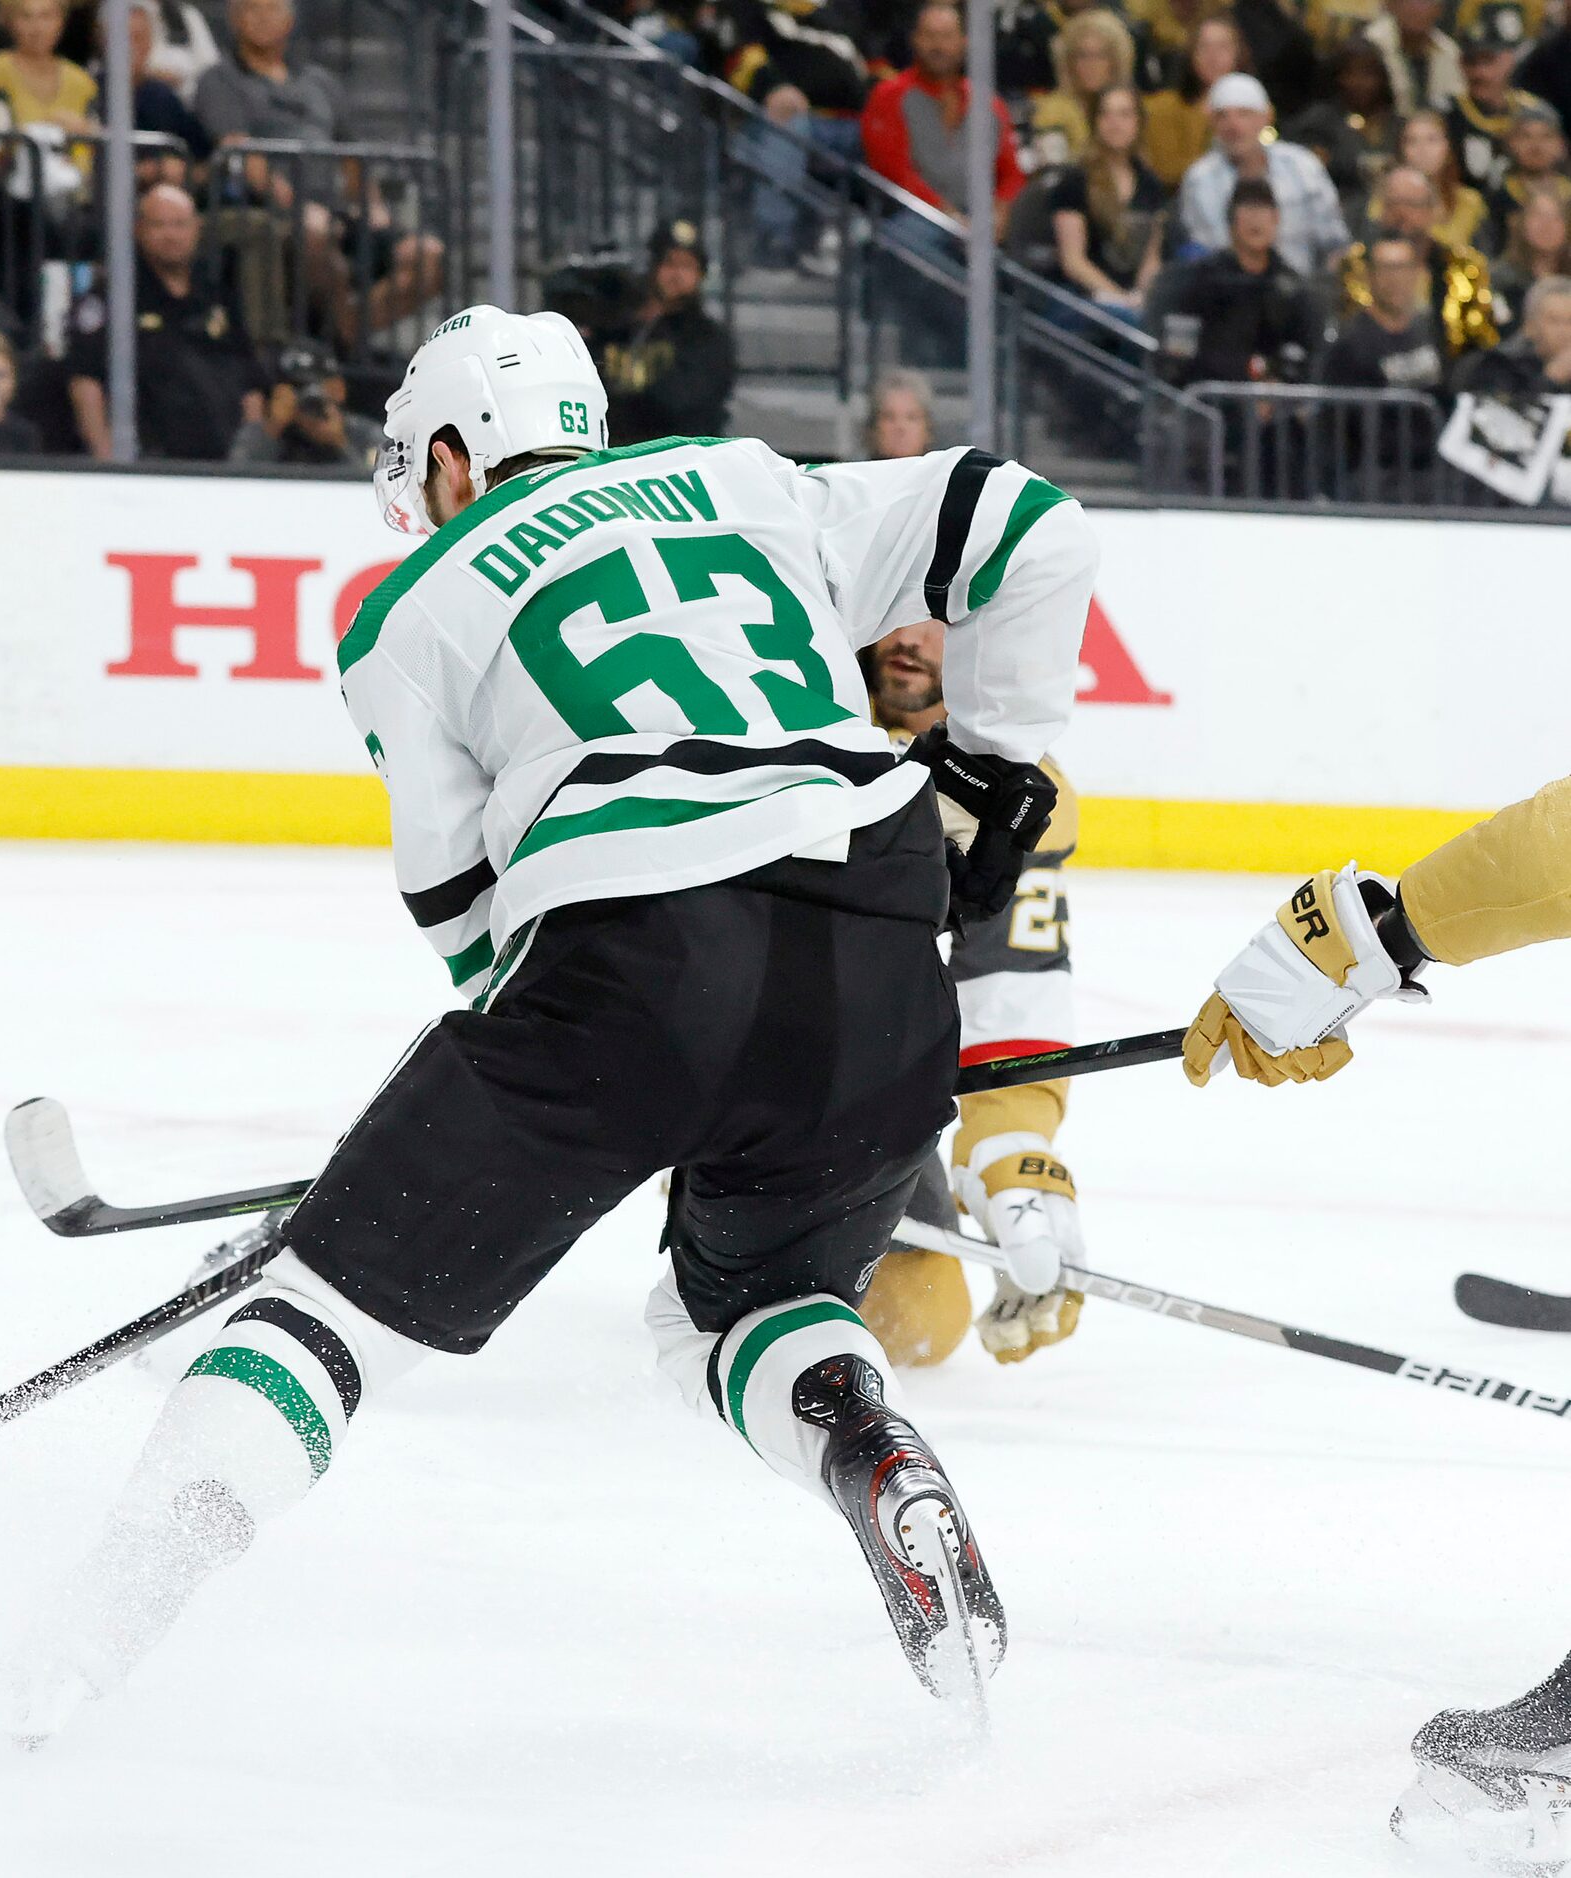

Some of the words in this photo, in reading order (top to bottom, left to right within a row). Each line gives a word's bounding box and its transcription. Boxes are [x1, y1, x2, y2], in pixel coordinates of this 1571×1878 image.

[559, 400, 589, 435] 63
[469, 469, 719, 598] DADONOV
[508, 533, 859, 742] 63
[1007, 867, 1070, 953] 2
[1312, 1003, 1356, 1044] WHITECLOUD
